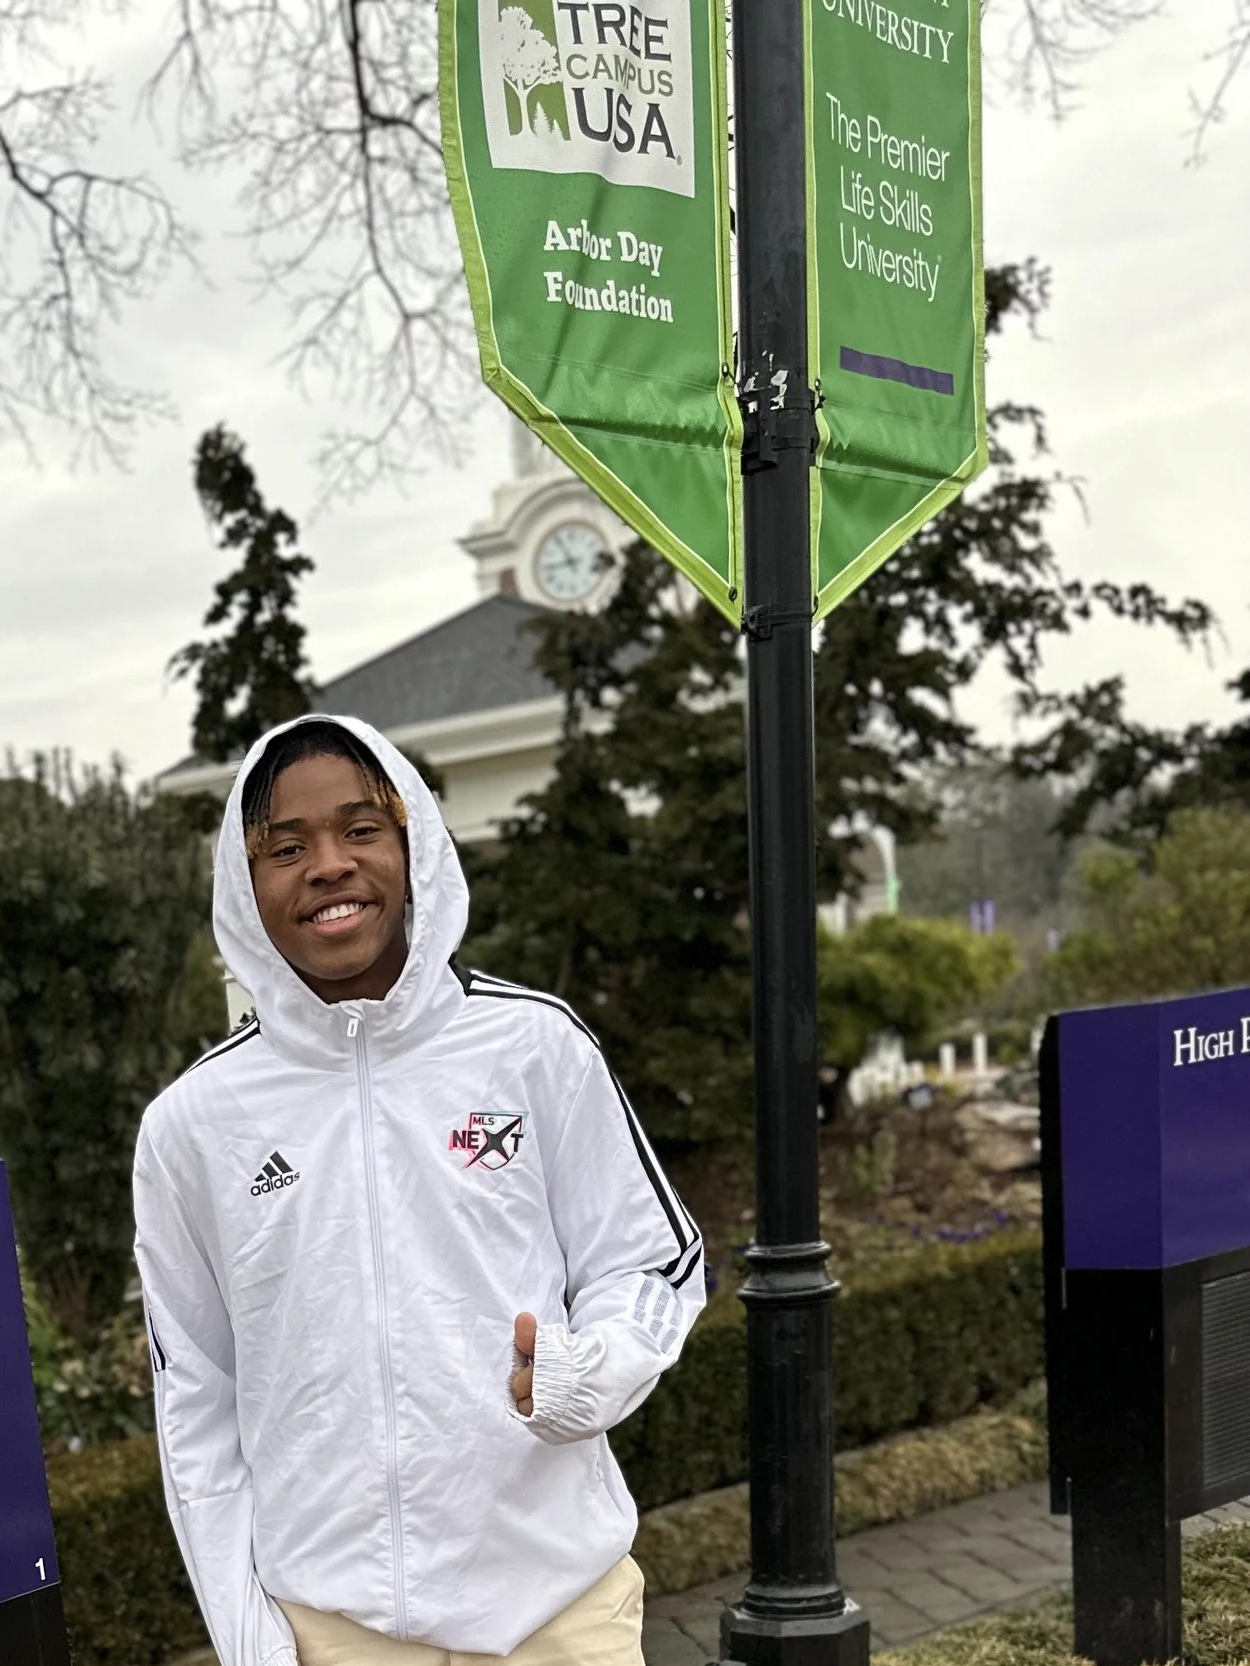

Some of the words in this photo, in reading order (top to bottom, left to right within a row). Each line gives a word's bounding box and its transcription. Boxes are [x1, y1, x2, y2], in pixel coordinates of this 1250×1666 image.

[557, 1, 673, 63] TREE
[566, 53, 674, 97] CAMPUS
[571, 87, 676, 160] USA
[826, 92, 861, 153] The
[867, 114, 950, 181] Premier
[840, 165, 875, 220] Life
[879, 180, 933, 236] Skills
[543, 219, 612, 261] Arbor
[617, 231, 663, 277] Day
[840, 222, 940, 302] University
[543, 271, 674, 323] Foundation
[1173, 1026, 1235, 1067] HIGH
[451, 1121, 524, 1164] NEXT
[472, 1116, 495, 1126] MLS
[250, 1172, 300, 1197] adidas
[34, 1557, 47, 1581] 1
